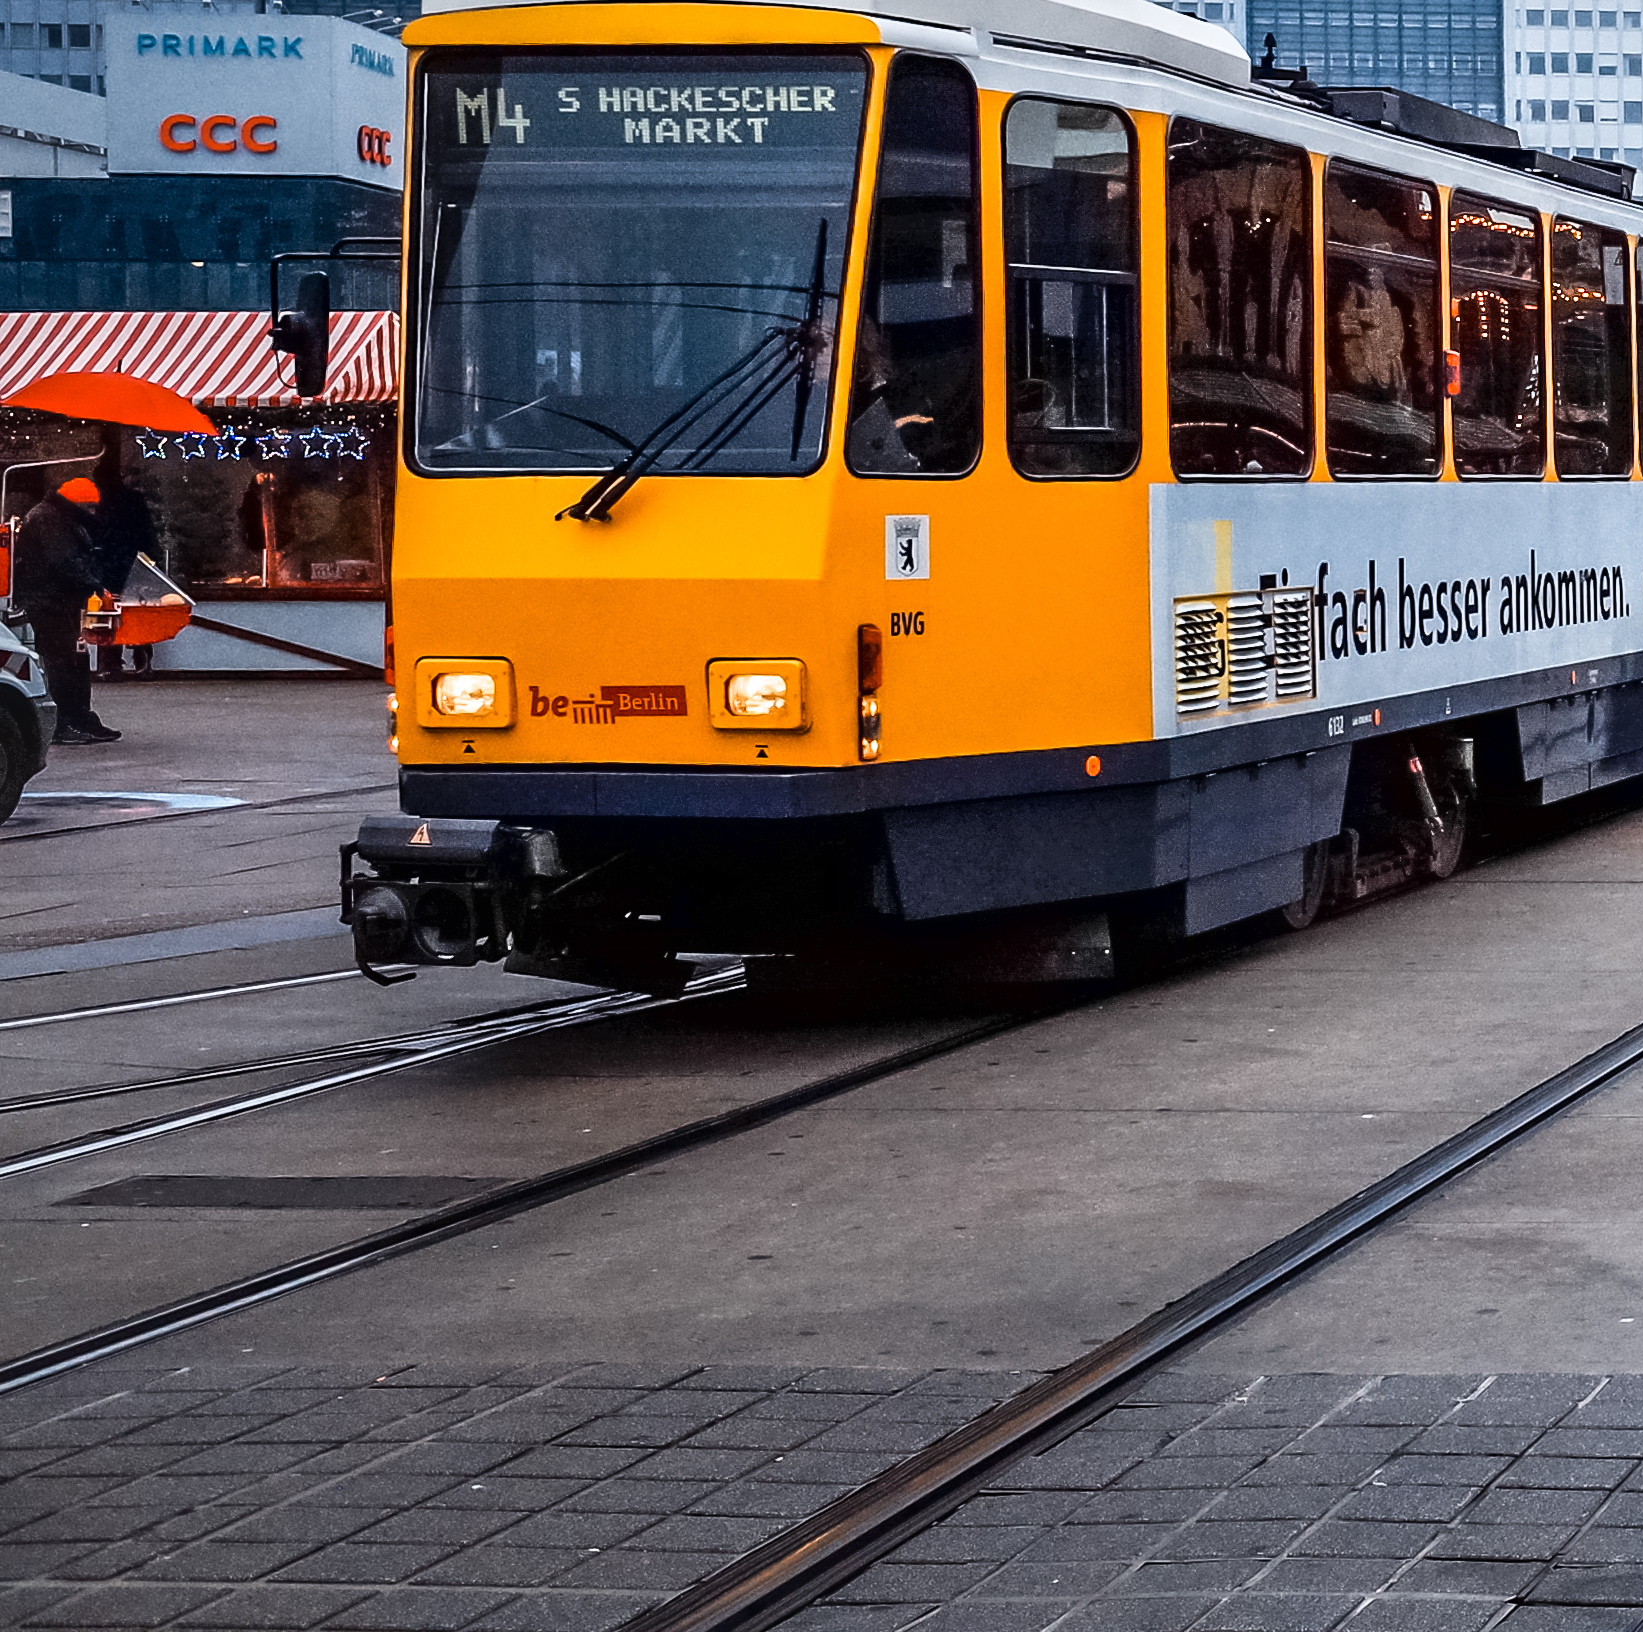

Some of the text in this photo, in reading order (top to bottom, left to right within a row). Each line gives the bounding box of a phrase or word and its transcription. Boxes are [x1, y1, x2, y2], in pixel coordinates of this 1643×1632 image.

[137, 33, 304, 58] PRIMARK
[351, 43, 395, 77] PRIMARK
[456, 87, 836, 144] M4 S HACKESCHER
[624, 117, 768, 144] MARKT
[158, 113, 278, 153] CCC
[357, 124, 392, 167] CCC
[1399, 557, 1490, 649] besser
[1500, 548, 1630, 636] ankommen.
[890, 611, 925, 636] BVG
[528, 685, 679, 717] be Berlin
[1328, 715, 1344, 737] 6132
